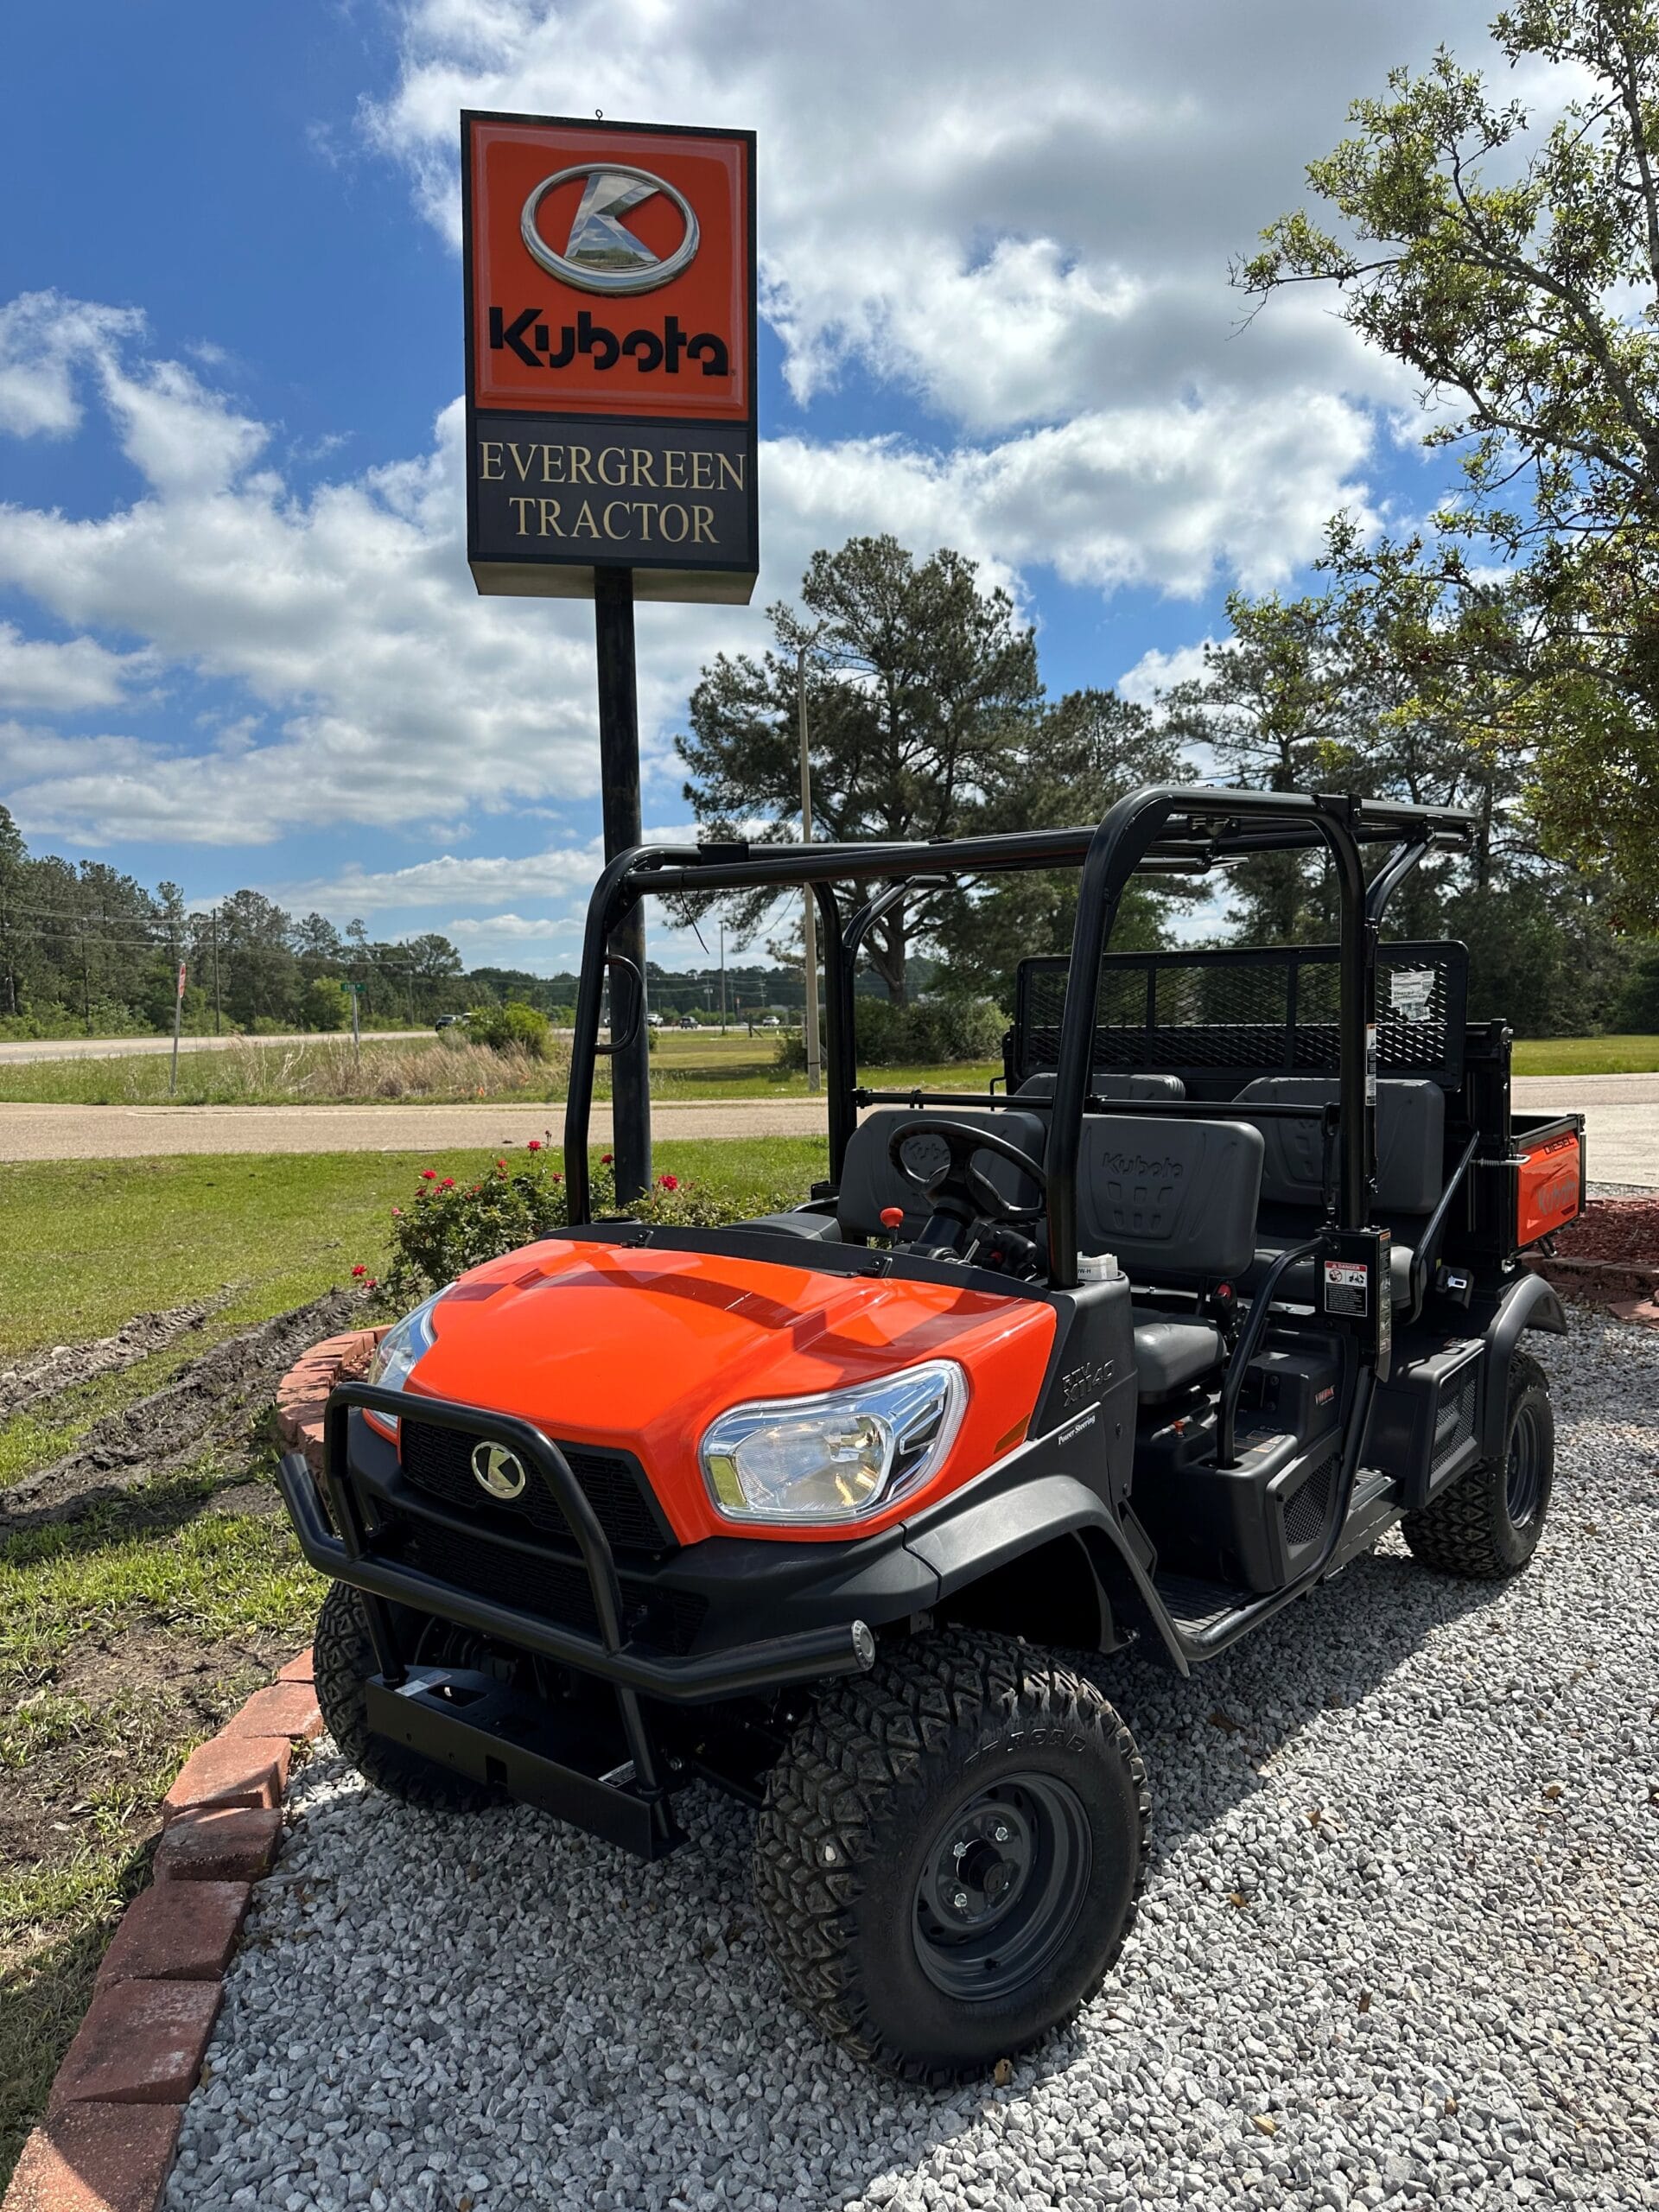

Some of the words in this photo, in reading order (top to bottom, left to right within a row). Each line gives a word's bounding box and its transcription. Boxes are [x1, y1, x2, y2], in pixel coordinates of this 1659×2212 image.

[488, 306, 730, 377] Kubota
[479, 441, 747, 492] EVERGREEN
[508, 496, 721, 544] TRACTOR
[904, 1141, 950, 1164] Kubo
[1543, 1136, 1574, 1155] DIESEL
[1102, 1151, 1184, 1178] Kubota
[1058, 1430, 1076, 1446] Power
[1075, 1414, 1096, 1434] Steering
